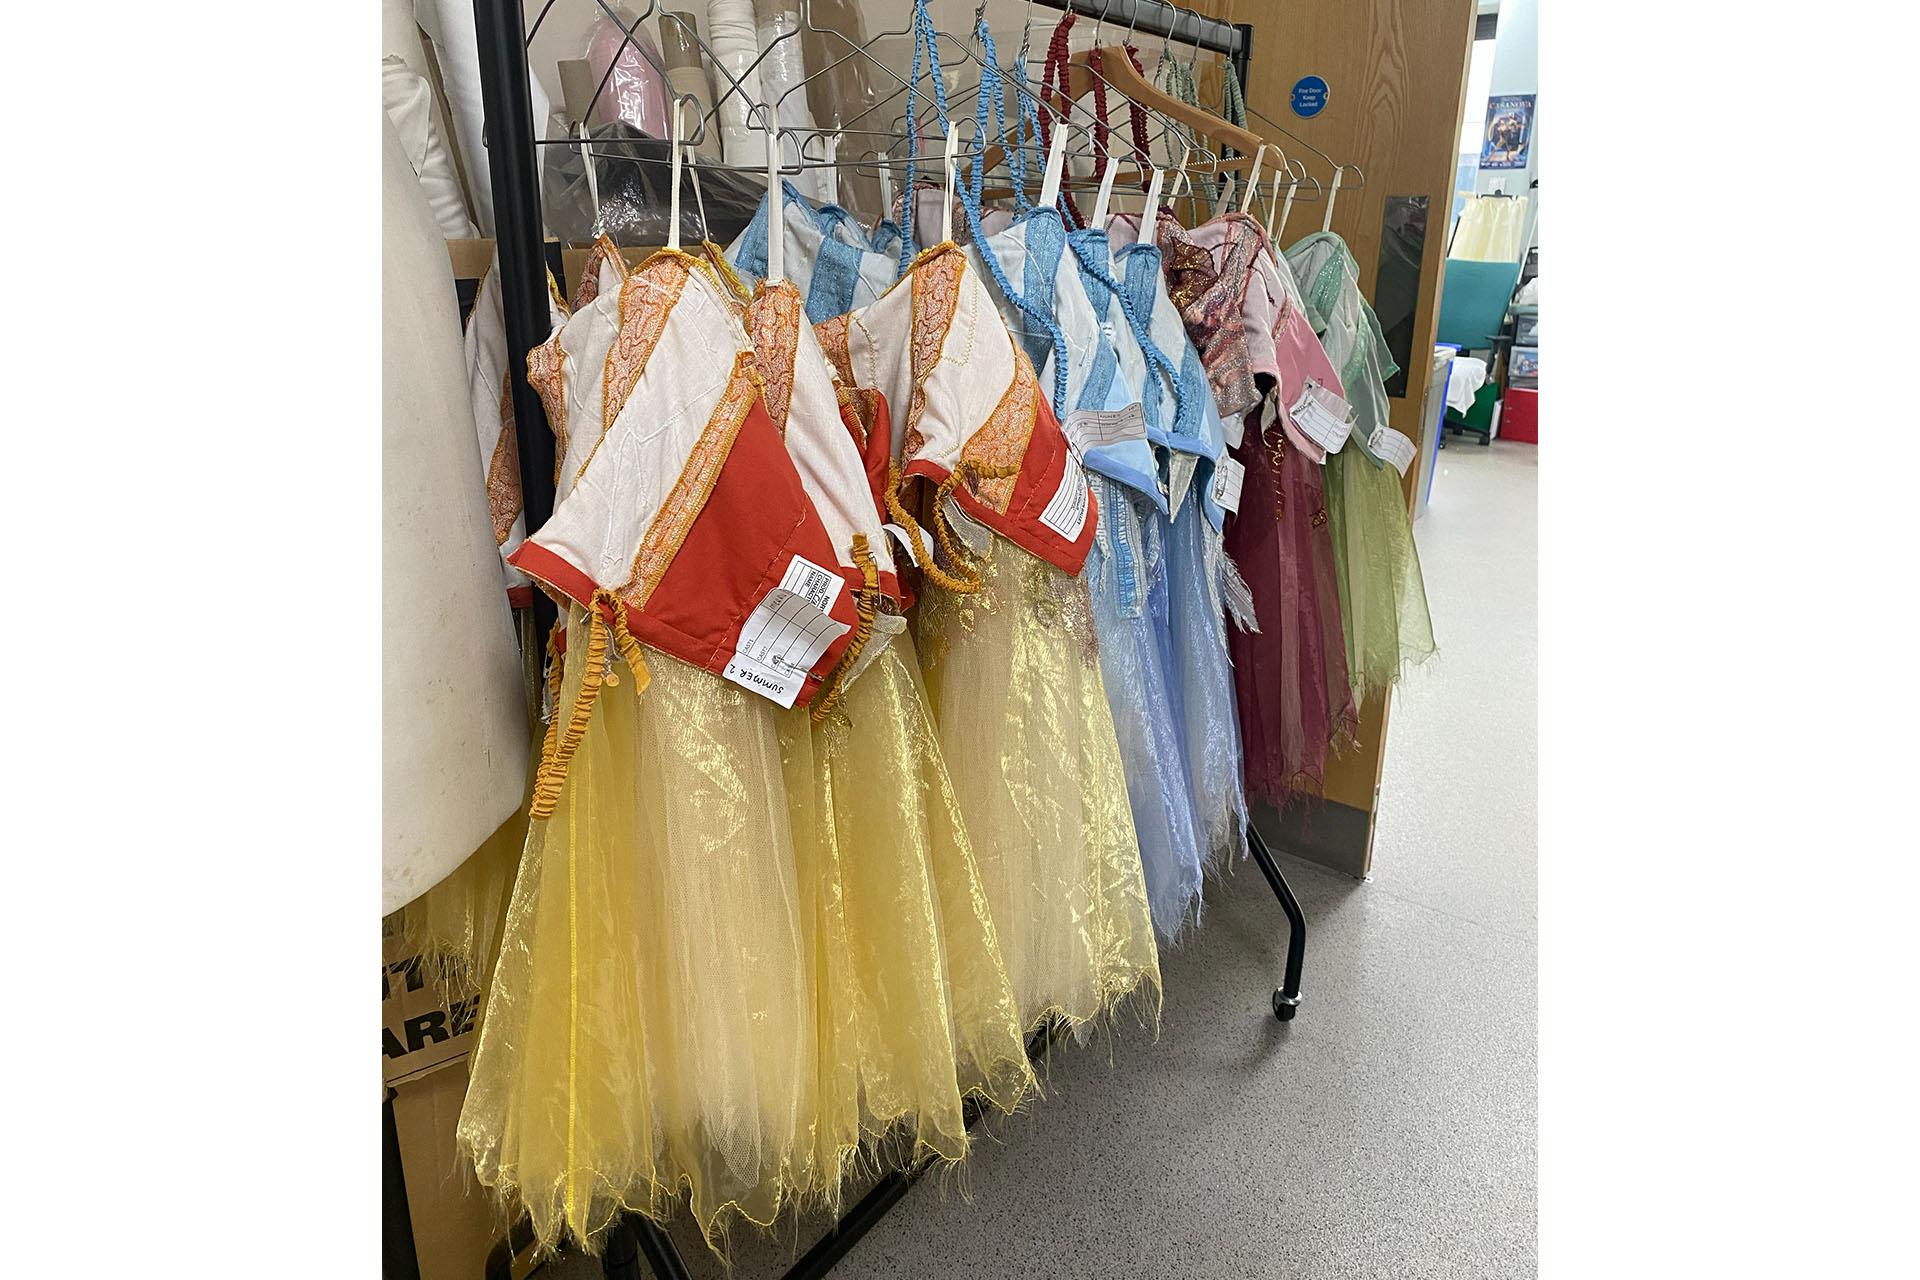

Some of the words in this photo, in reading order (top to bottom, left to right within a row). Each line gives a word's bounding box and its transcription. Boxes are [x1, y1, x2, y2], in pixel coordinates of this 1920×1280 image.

[805, 570, 816, 588] NAME
[807, 574, 822, 602] CHARACT
[820, 595, 830, 612] NOR
[742, 639, 754, 654] CAST1
[729, 663, 736, 674] 2
[739, 668, 784, 694] SUMMER
